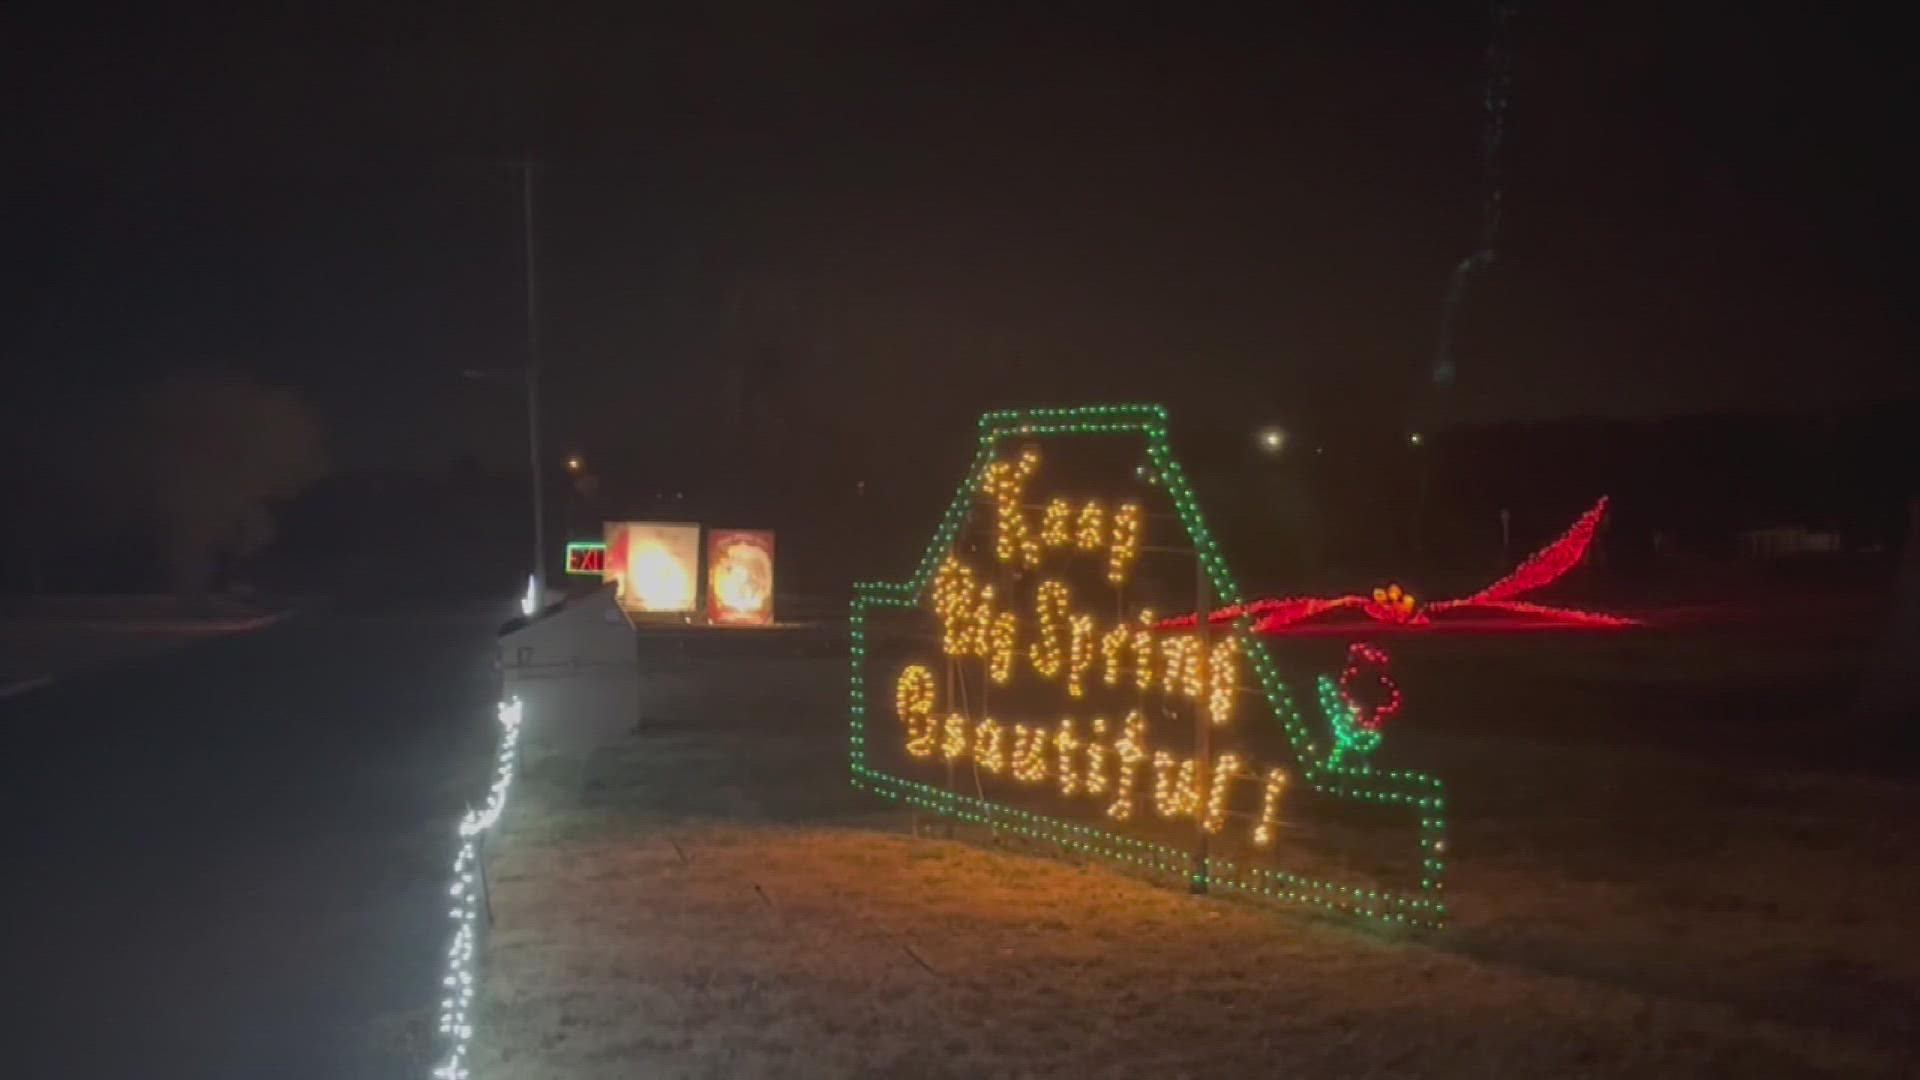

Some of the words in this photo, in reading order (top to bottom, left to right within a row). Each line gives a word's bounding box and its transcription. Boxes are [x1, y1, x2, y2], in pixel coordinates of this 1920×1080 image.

[984, 450, 1138, 582] Keep
[933, 556, 1016, 682] Big
[1030, 580, 1238, 723] Spring
